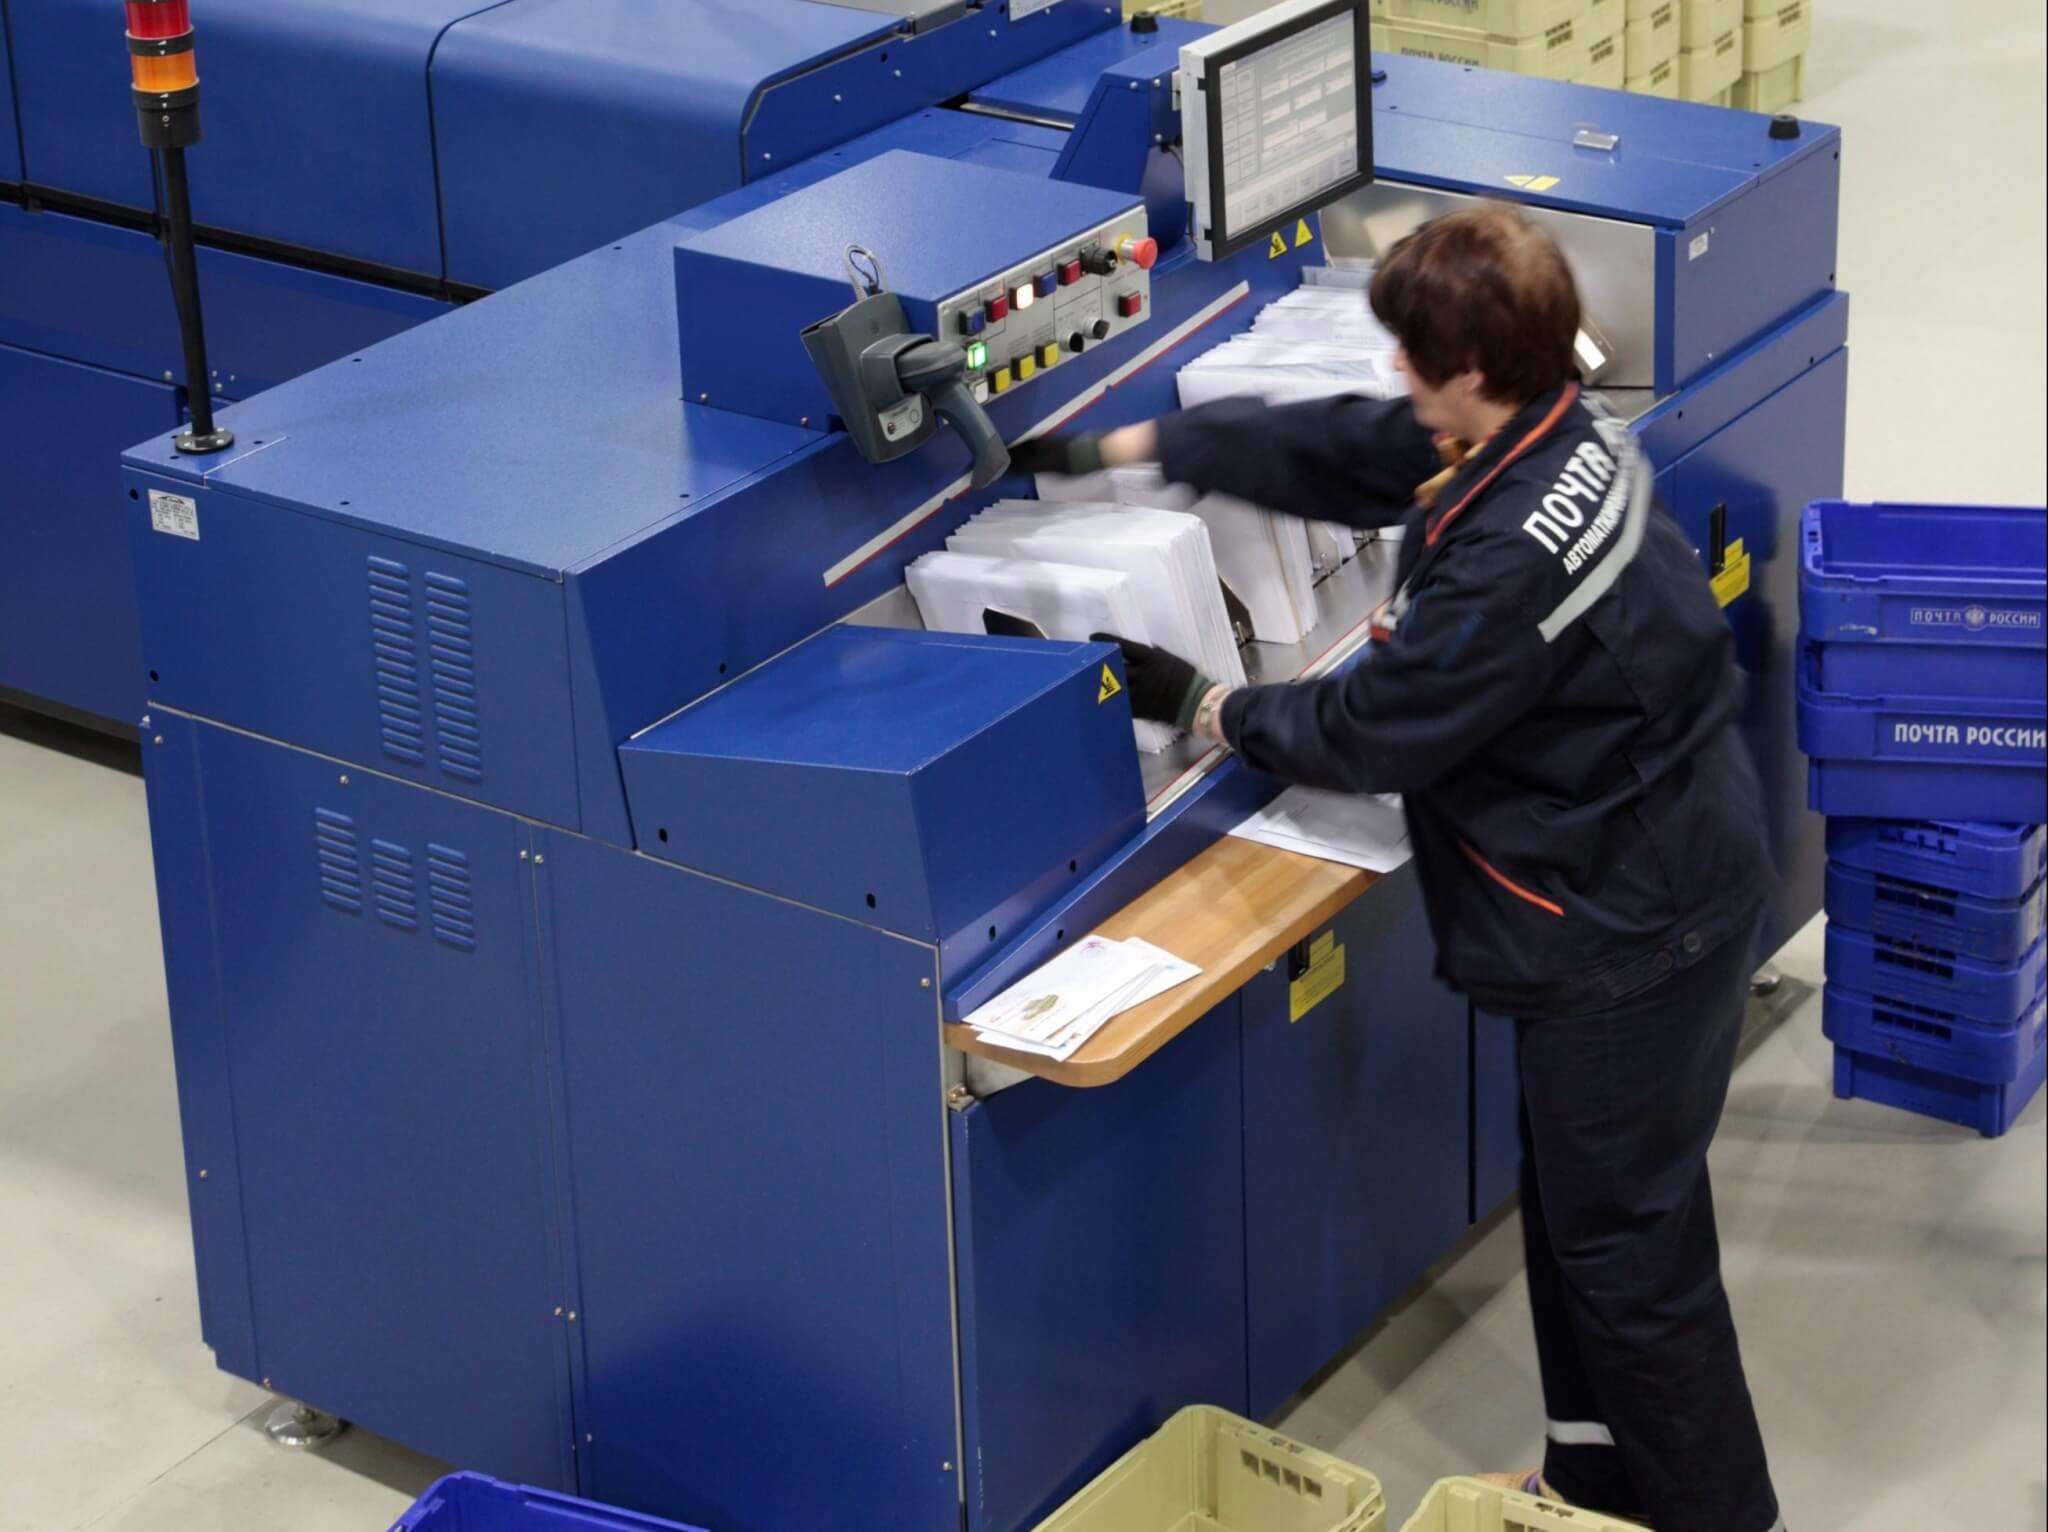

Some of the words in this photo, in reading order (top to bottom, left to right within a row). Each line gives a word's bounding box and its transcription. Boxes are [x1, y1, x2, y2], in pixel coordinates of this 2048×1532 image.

[1522, 441, 1617, 554] ПОЧТА
[1914, 610, 1961, 623] ПОЧТА
[1989, 612, 2037, 625] РОССИИ
[1894, 723, 1960, 745] ПОЧТА
[1966, 726, 2047, 748] РОССИИ
